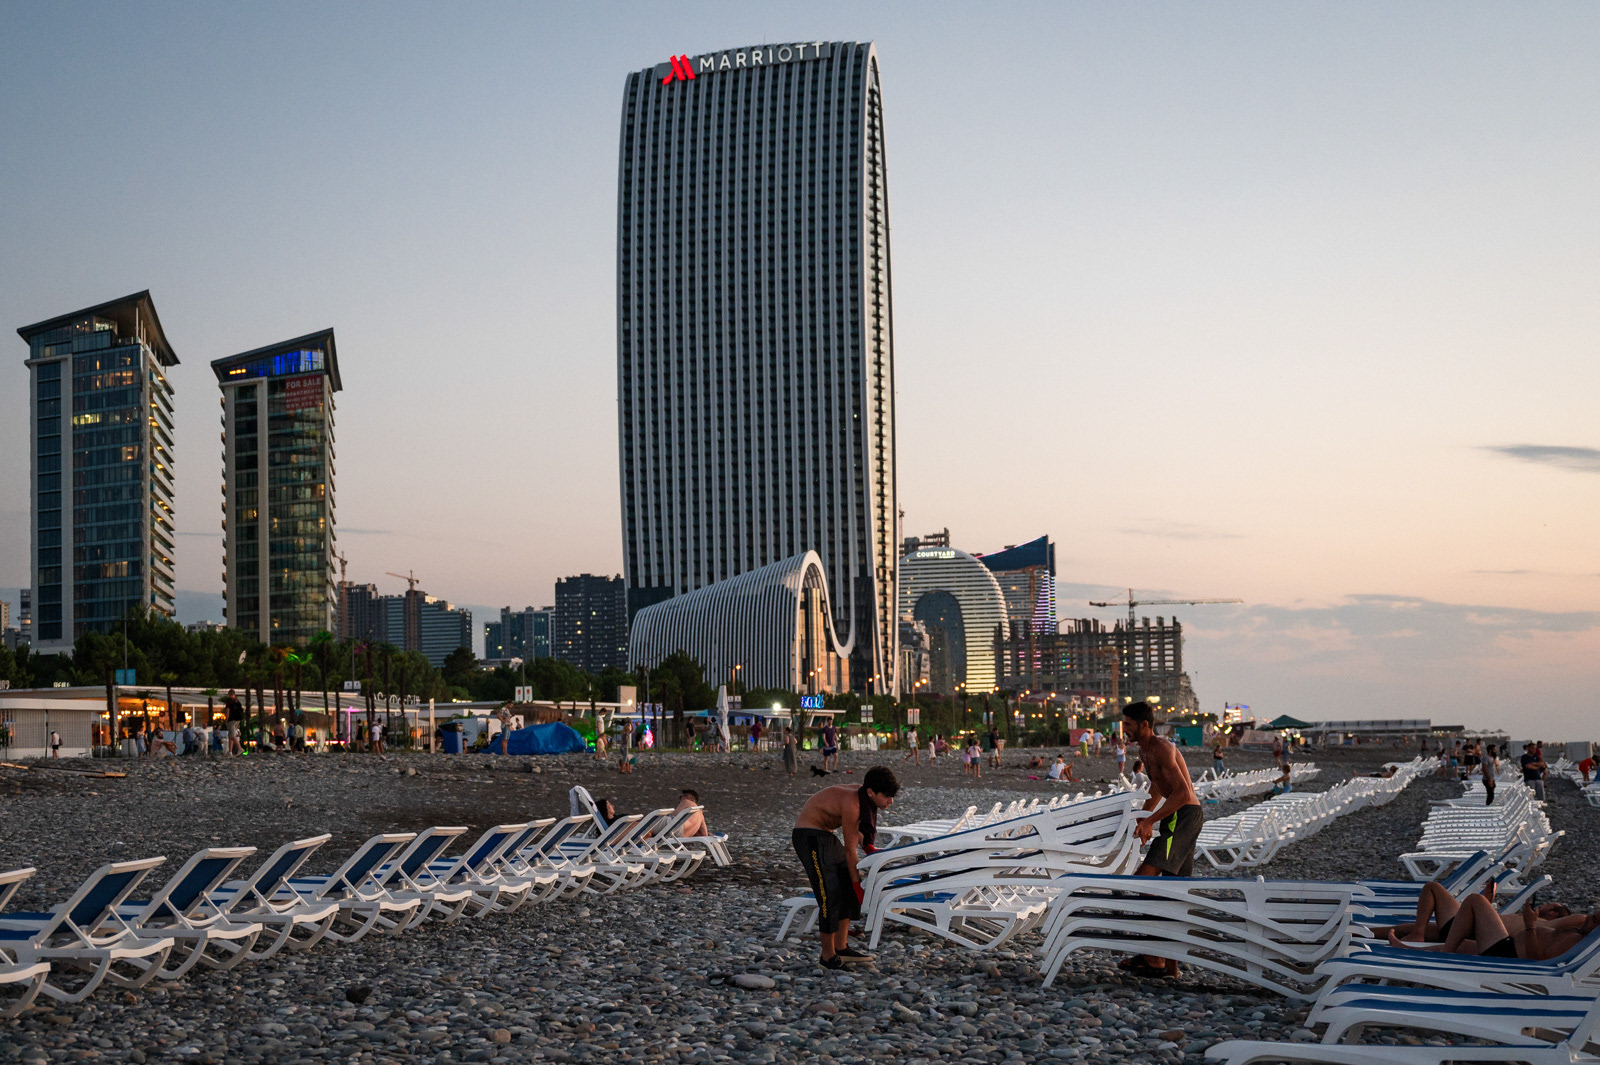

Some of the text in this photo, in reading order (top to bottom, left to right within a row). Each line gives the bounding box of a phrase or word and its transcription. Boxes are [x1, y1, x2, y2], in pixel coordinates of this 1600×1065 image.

[700, 41, 824, 72] MARRIOTT
[286, 377, 321, 389] FOR SALE
[916, 550, 956, 558] COURTYARD
